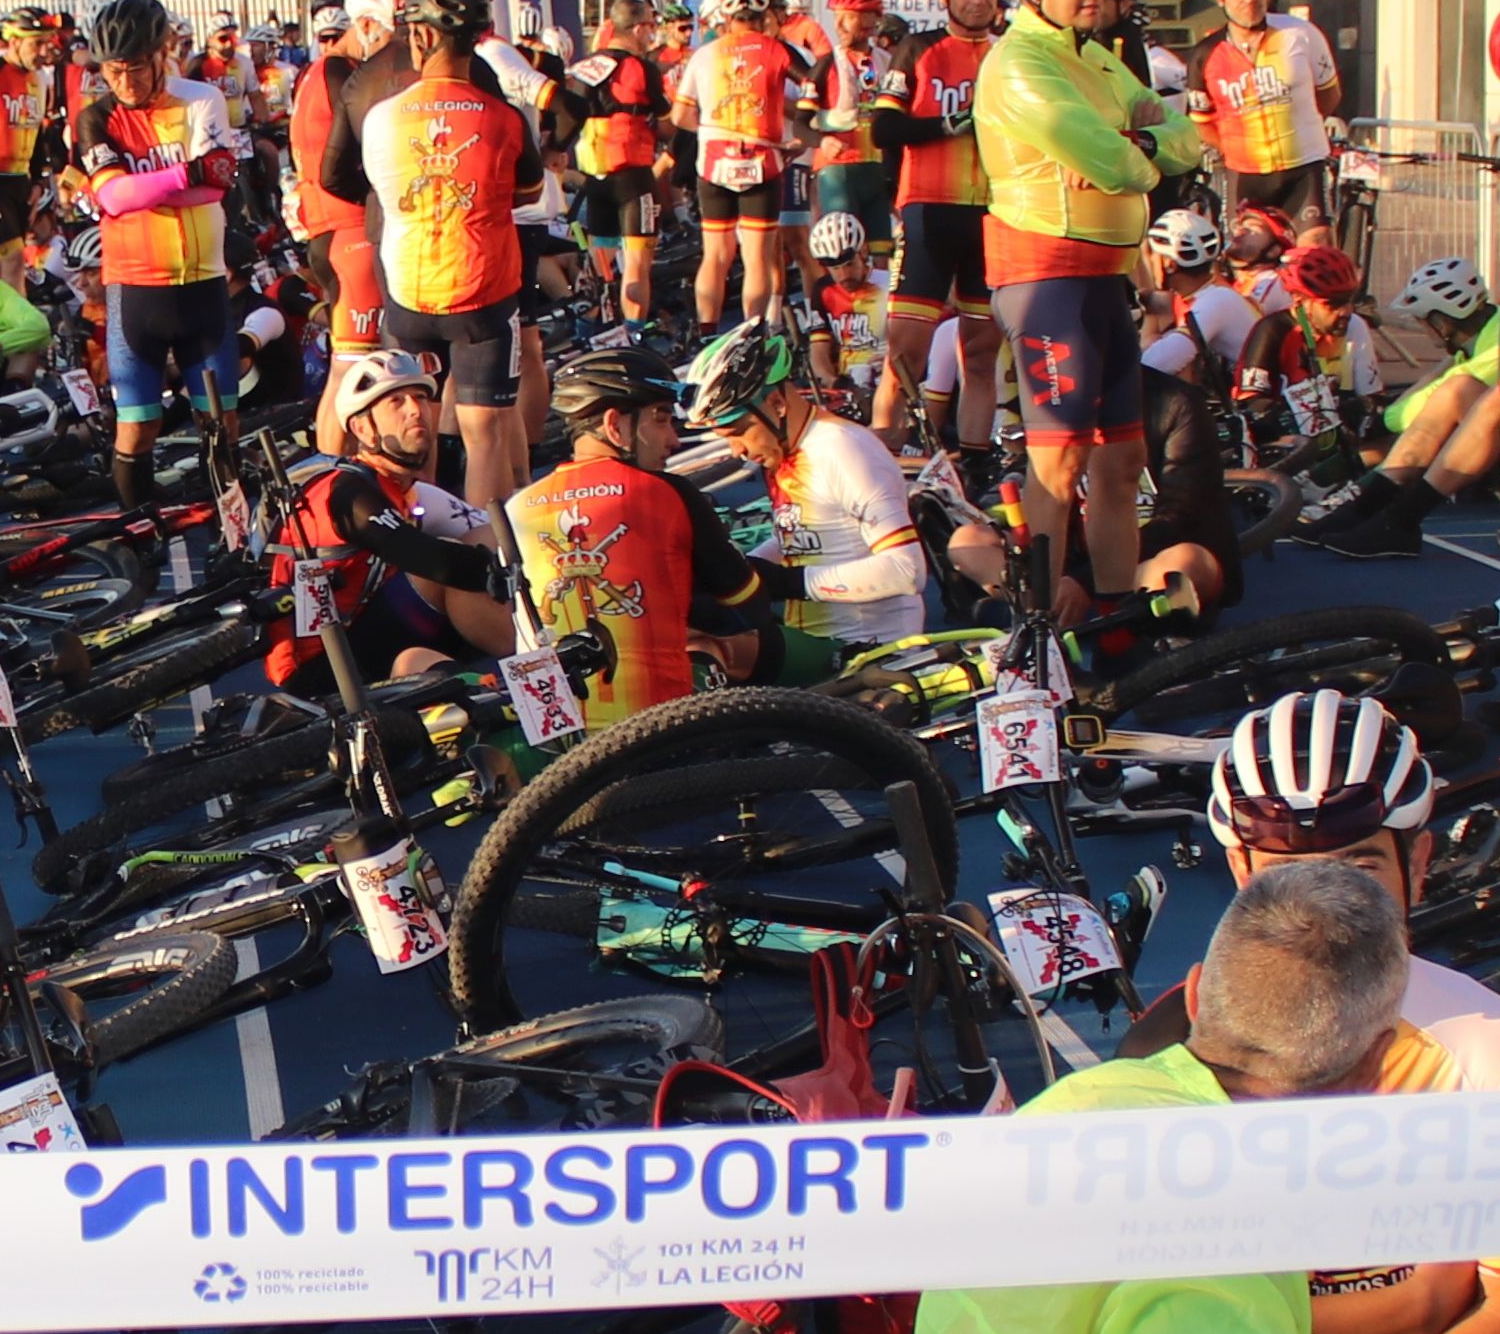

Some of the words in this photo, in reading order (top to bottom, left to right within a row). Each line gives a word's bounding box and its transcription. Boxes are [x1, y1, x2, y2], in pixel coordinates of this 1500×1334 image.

[424, 97, 485, 113] LEGIÓN
[526, 494, 549, 508] LA
[553, 482, 625, 504] LEGIÓN
[537, 677, 570, 732] 4633
[1002, 721, 1032, 780] 6541
[398, 884, 436, 956] 4723
[1045, 915, 1086, 978] 4548
[188, 1132, 930, 1240] INTERSPORT
[494, 1247, 554, 1272] KM
[657, 1241, 694, 1258] 101
[701, 1238, 744, 1257] KM
[751, 1239, 780, 1257] 24
[787, 1235, 806, 1252] H
[255, 1268, 296, 1282] 100%
[298, 1267, 366, 1280] reciclado
[656, 1267, 693, 1287] LA
[700, 1259, 804, 1283] LEGIÓN
[255, 1283, 296, 1297] 100%
[298, 1281, 370, 1295] reciclable
[480, 1274, 556, 1302] 24H
